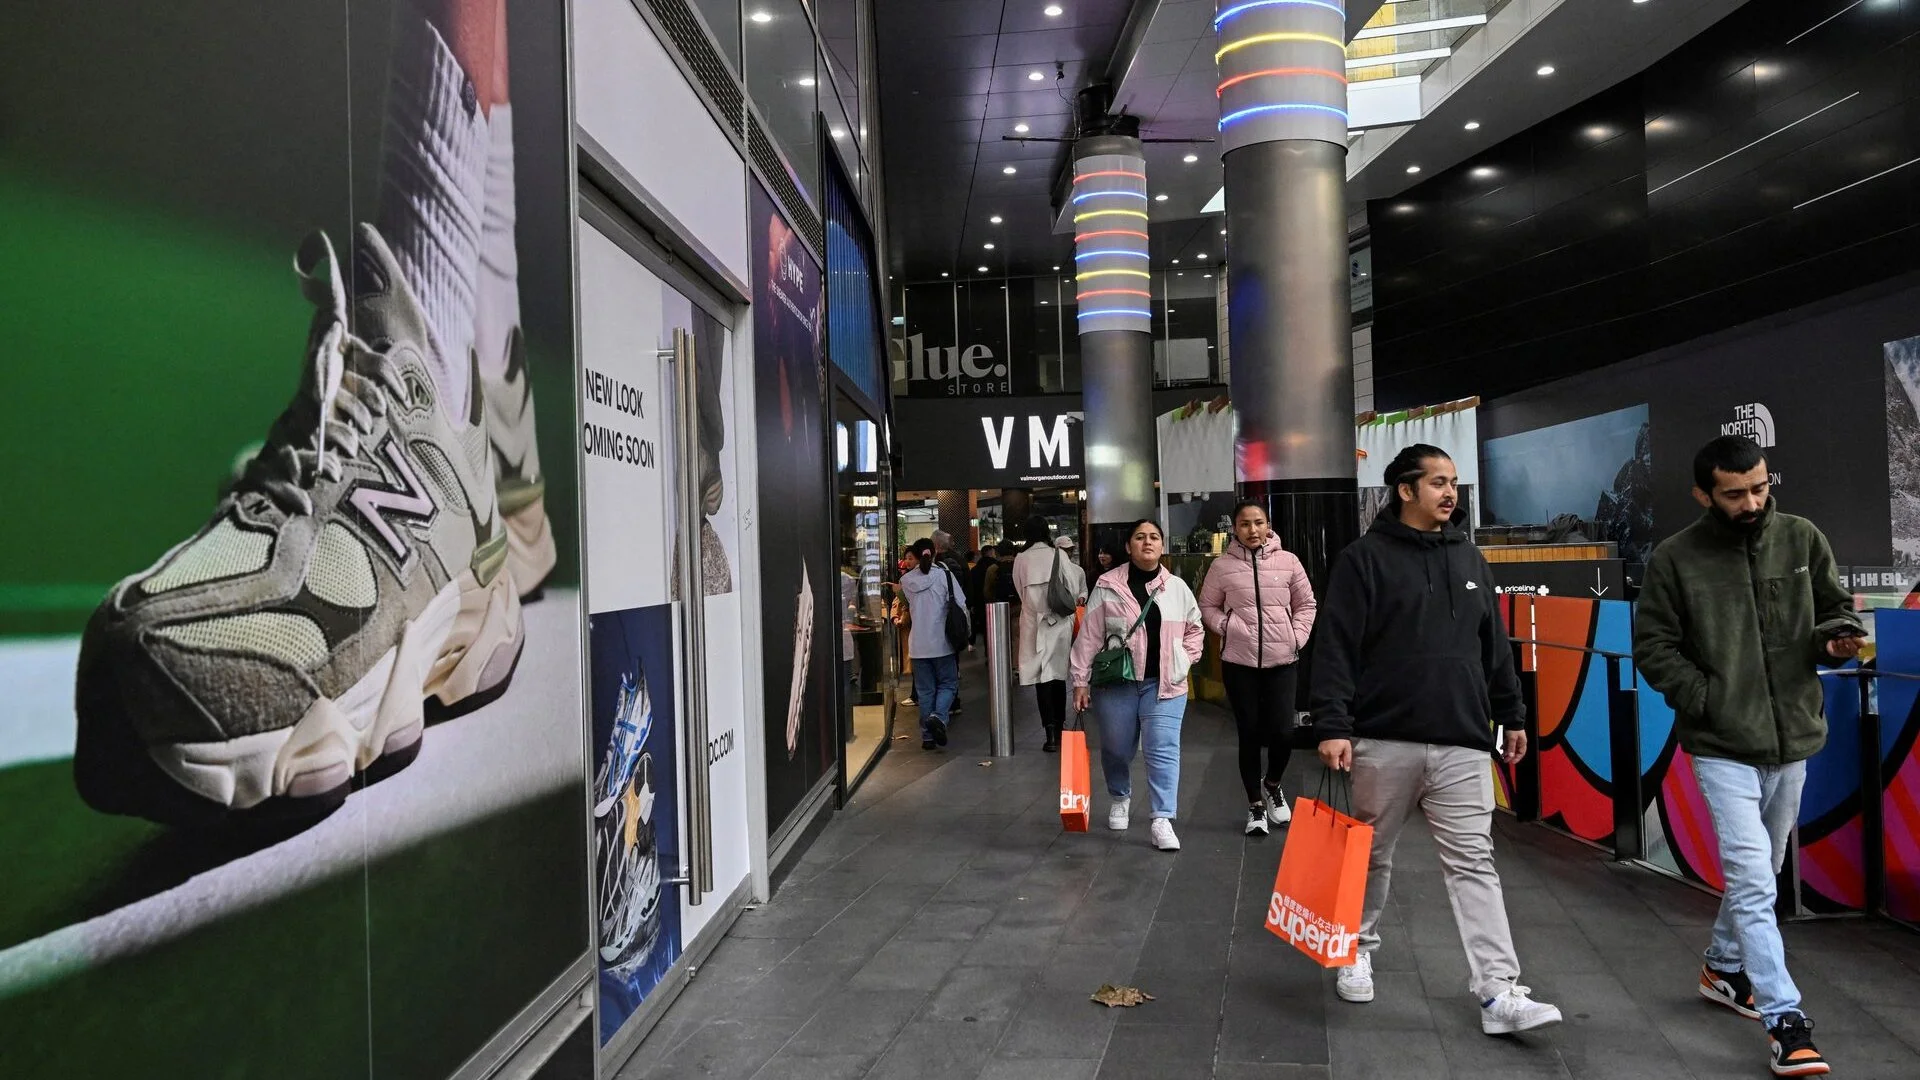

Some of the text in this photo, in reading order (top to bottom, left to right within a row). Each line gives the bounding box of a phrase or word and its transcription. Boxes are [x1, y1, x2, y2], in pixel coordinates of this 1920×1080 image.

[787, 255, 804, 294] HYPE
[585, 367, 644, 419] NEW LOOK
[947, 381, 1008, 395] STORE
[1734, 403, 1754, 420] THE
[1721, 418, 1755, 437] NORTH
[584, 422, 655, 469] OMING SOON
[1020, 474, 1080, 482] valmorganoutdoor.com
[1504, 585, 1536, 594] priceline
[1268, 891, 1359, 959] Superdr
